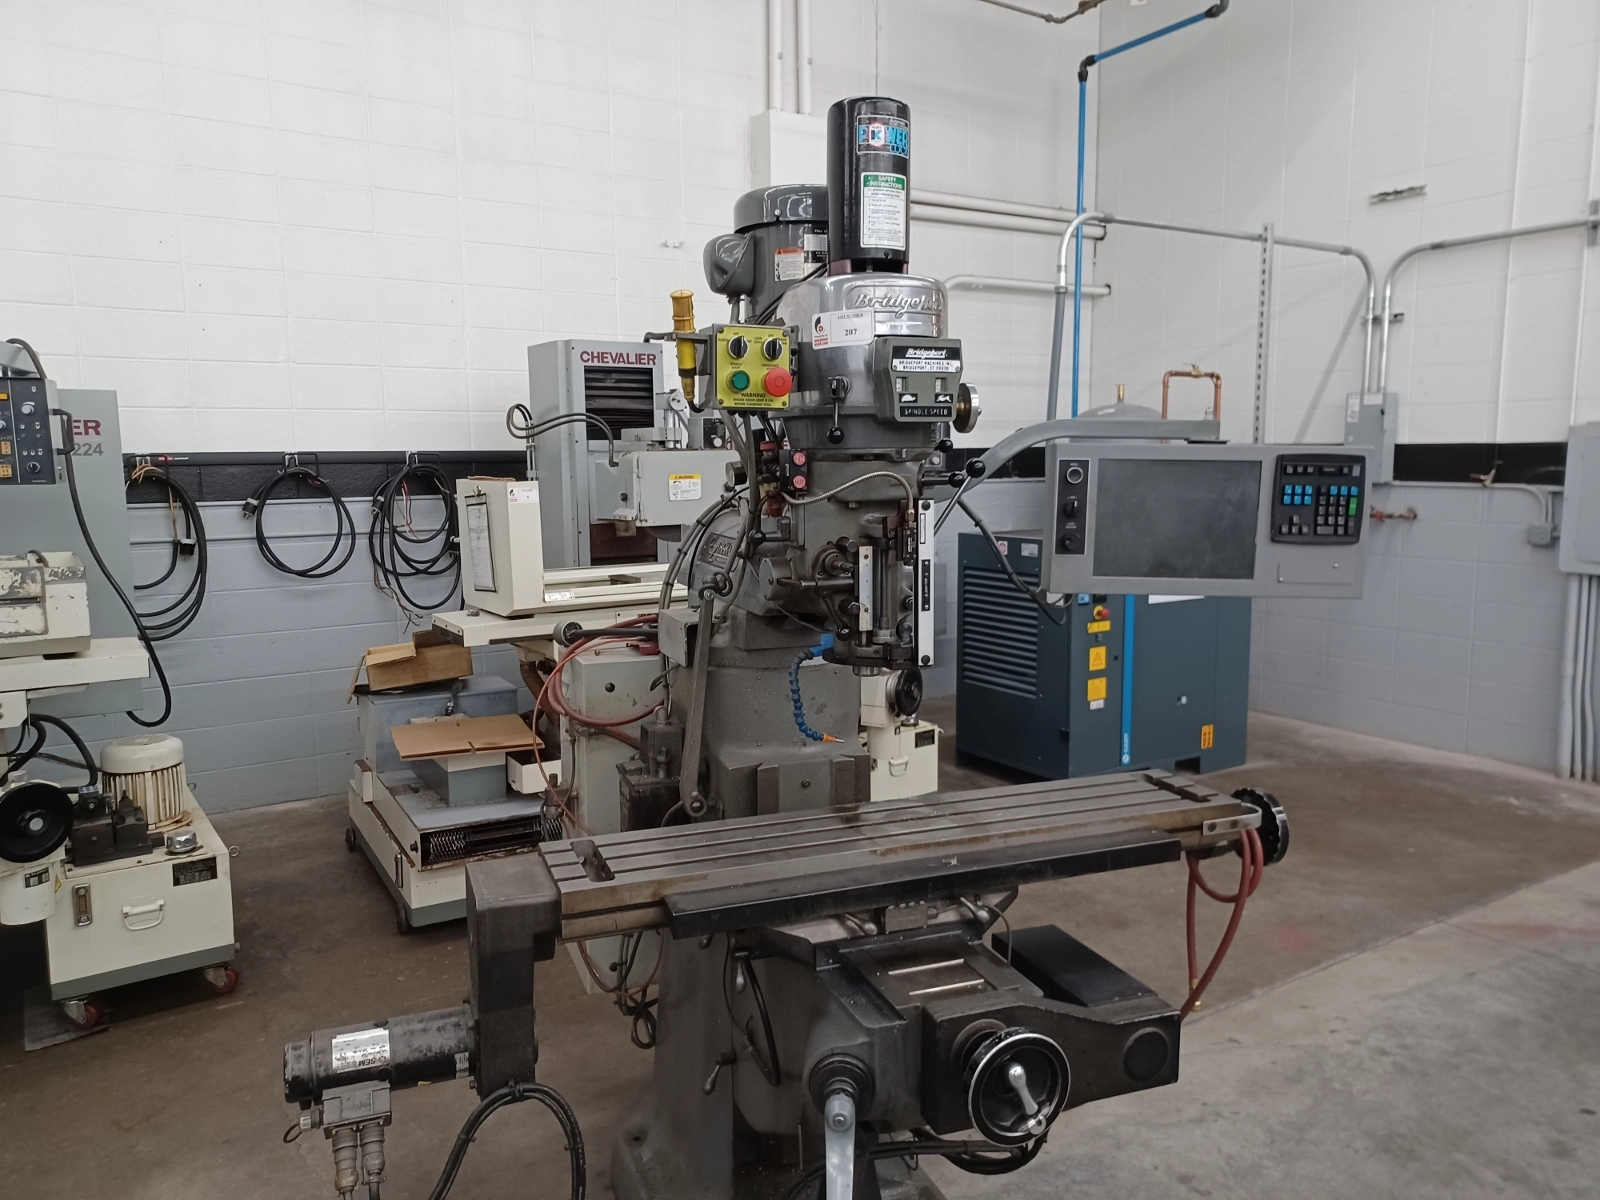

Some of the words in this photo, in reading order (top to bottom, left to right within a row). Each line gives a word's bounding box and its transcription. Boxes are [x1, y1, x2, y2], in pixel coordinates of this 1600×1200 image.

[580, 350, 657, 365] CHEVALIER
[72, 442, 104, 456] 224
[358, 1057, 376, 1067] SEM
